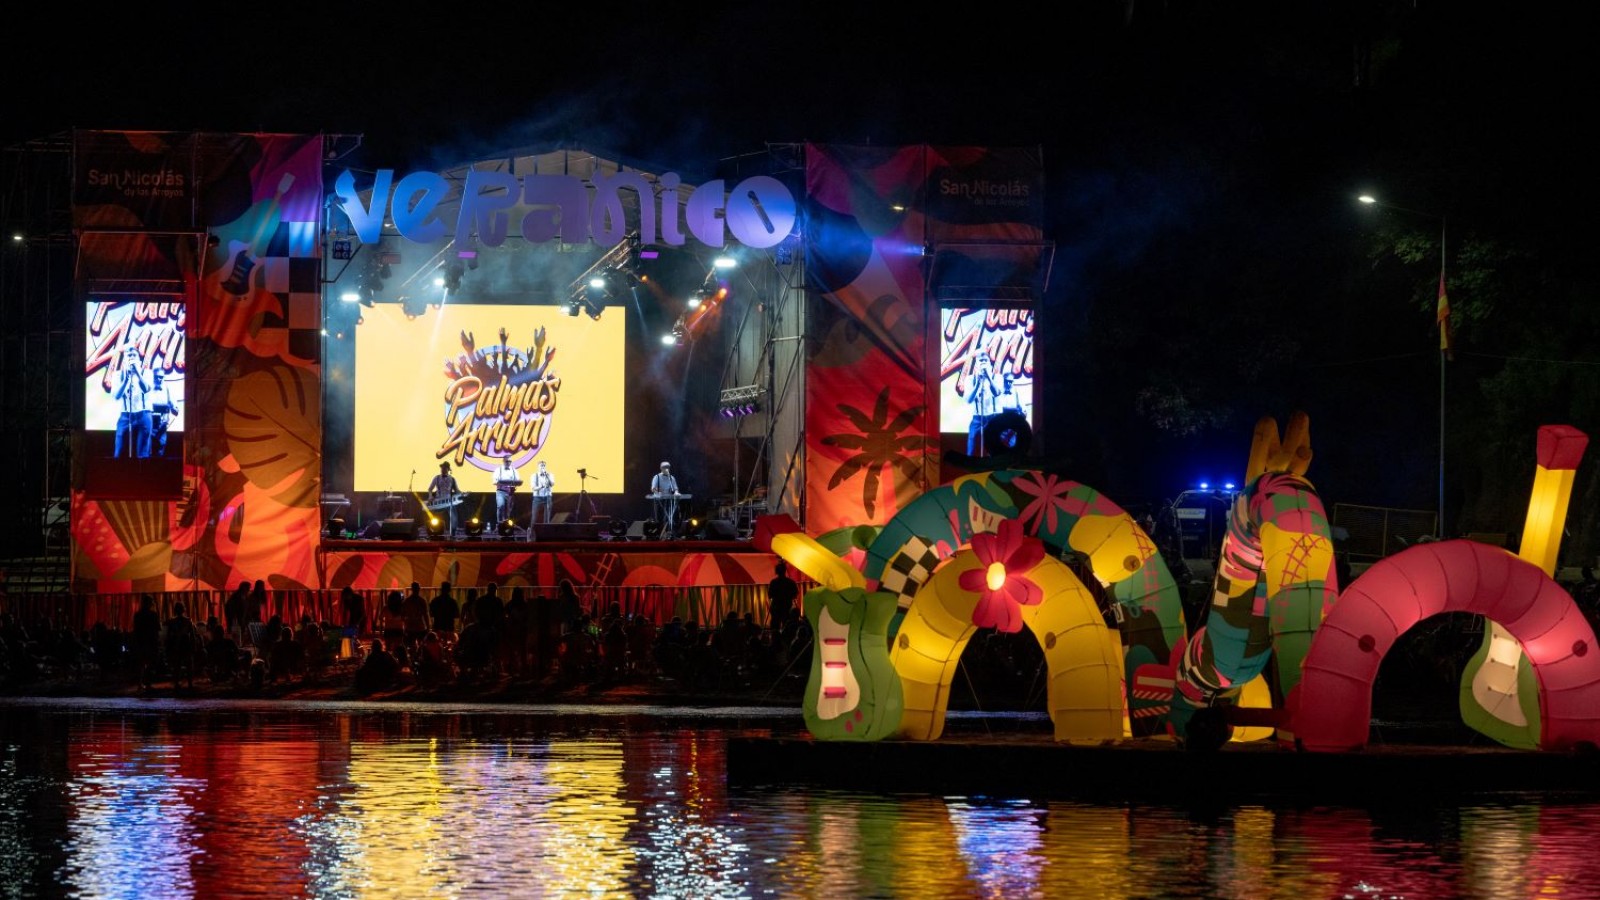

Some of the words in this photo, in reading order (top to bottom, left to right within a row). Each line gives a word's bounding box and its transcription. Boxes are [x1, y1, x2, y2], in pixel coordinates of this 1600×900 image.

[88, 169, 122, 189] San
[122, 169, 184, 186] Nicolás
[940, 179, 972, 199] San
[972, 179, 1030, 196] Nicolás
[152, 187, 185, 199] Arroyos
[446, 374, 559, 428] Palmas
[435, 411, 544, 466] Arriba
